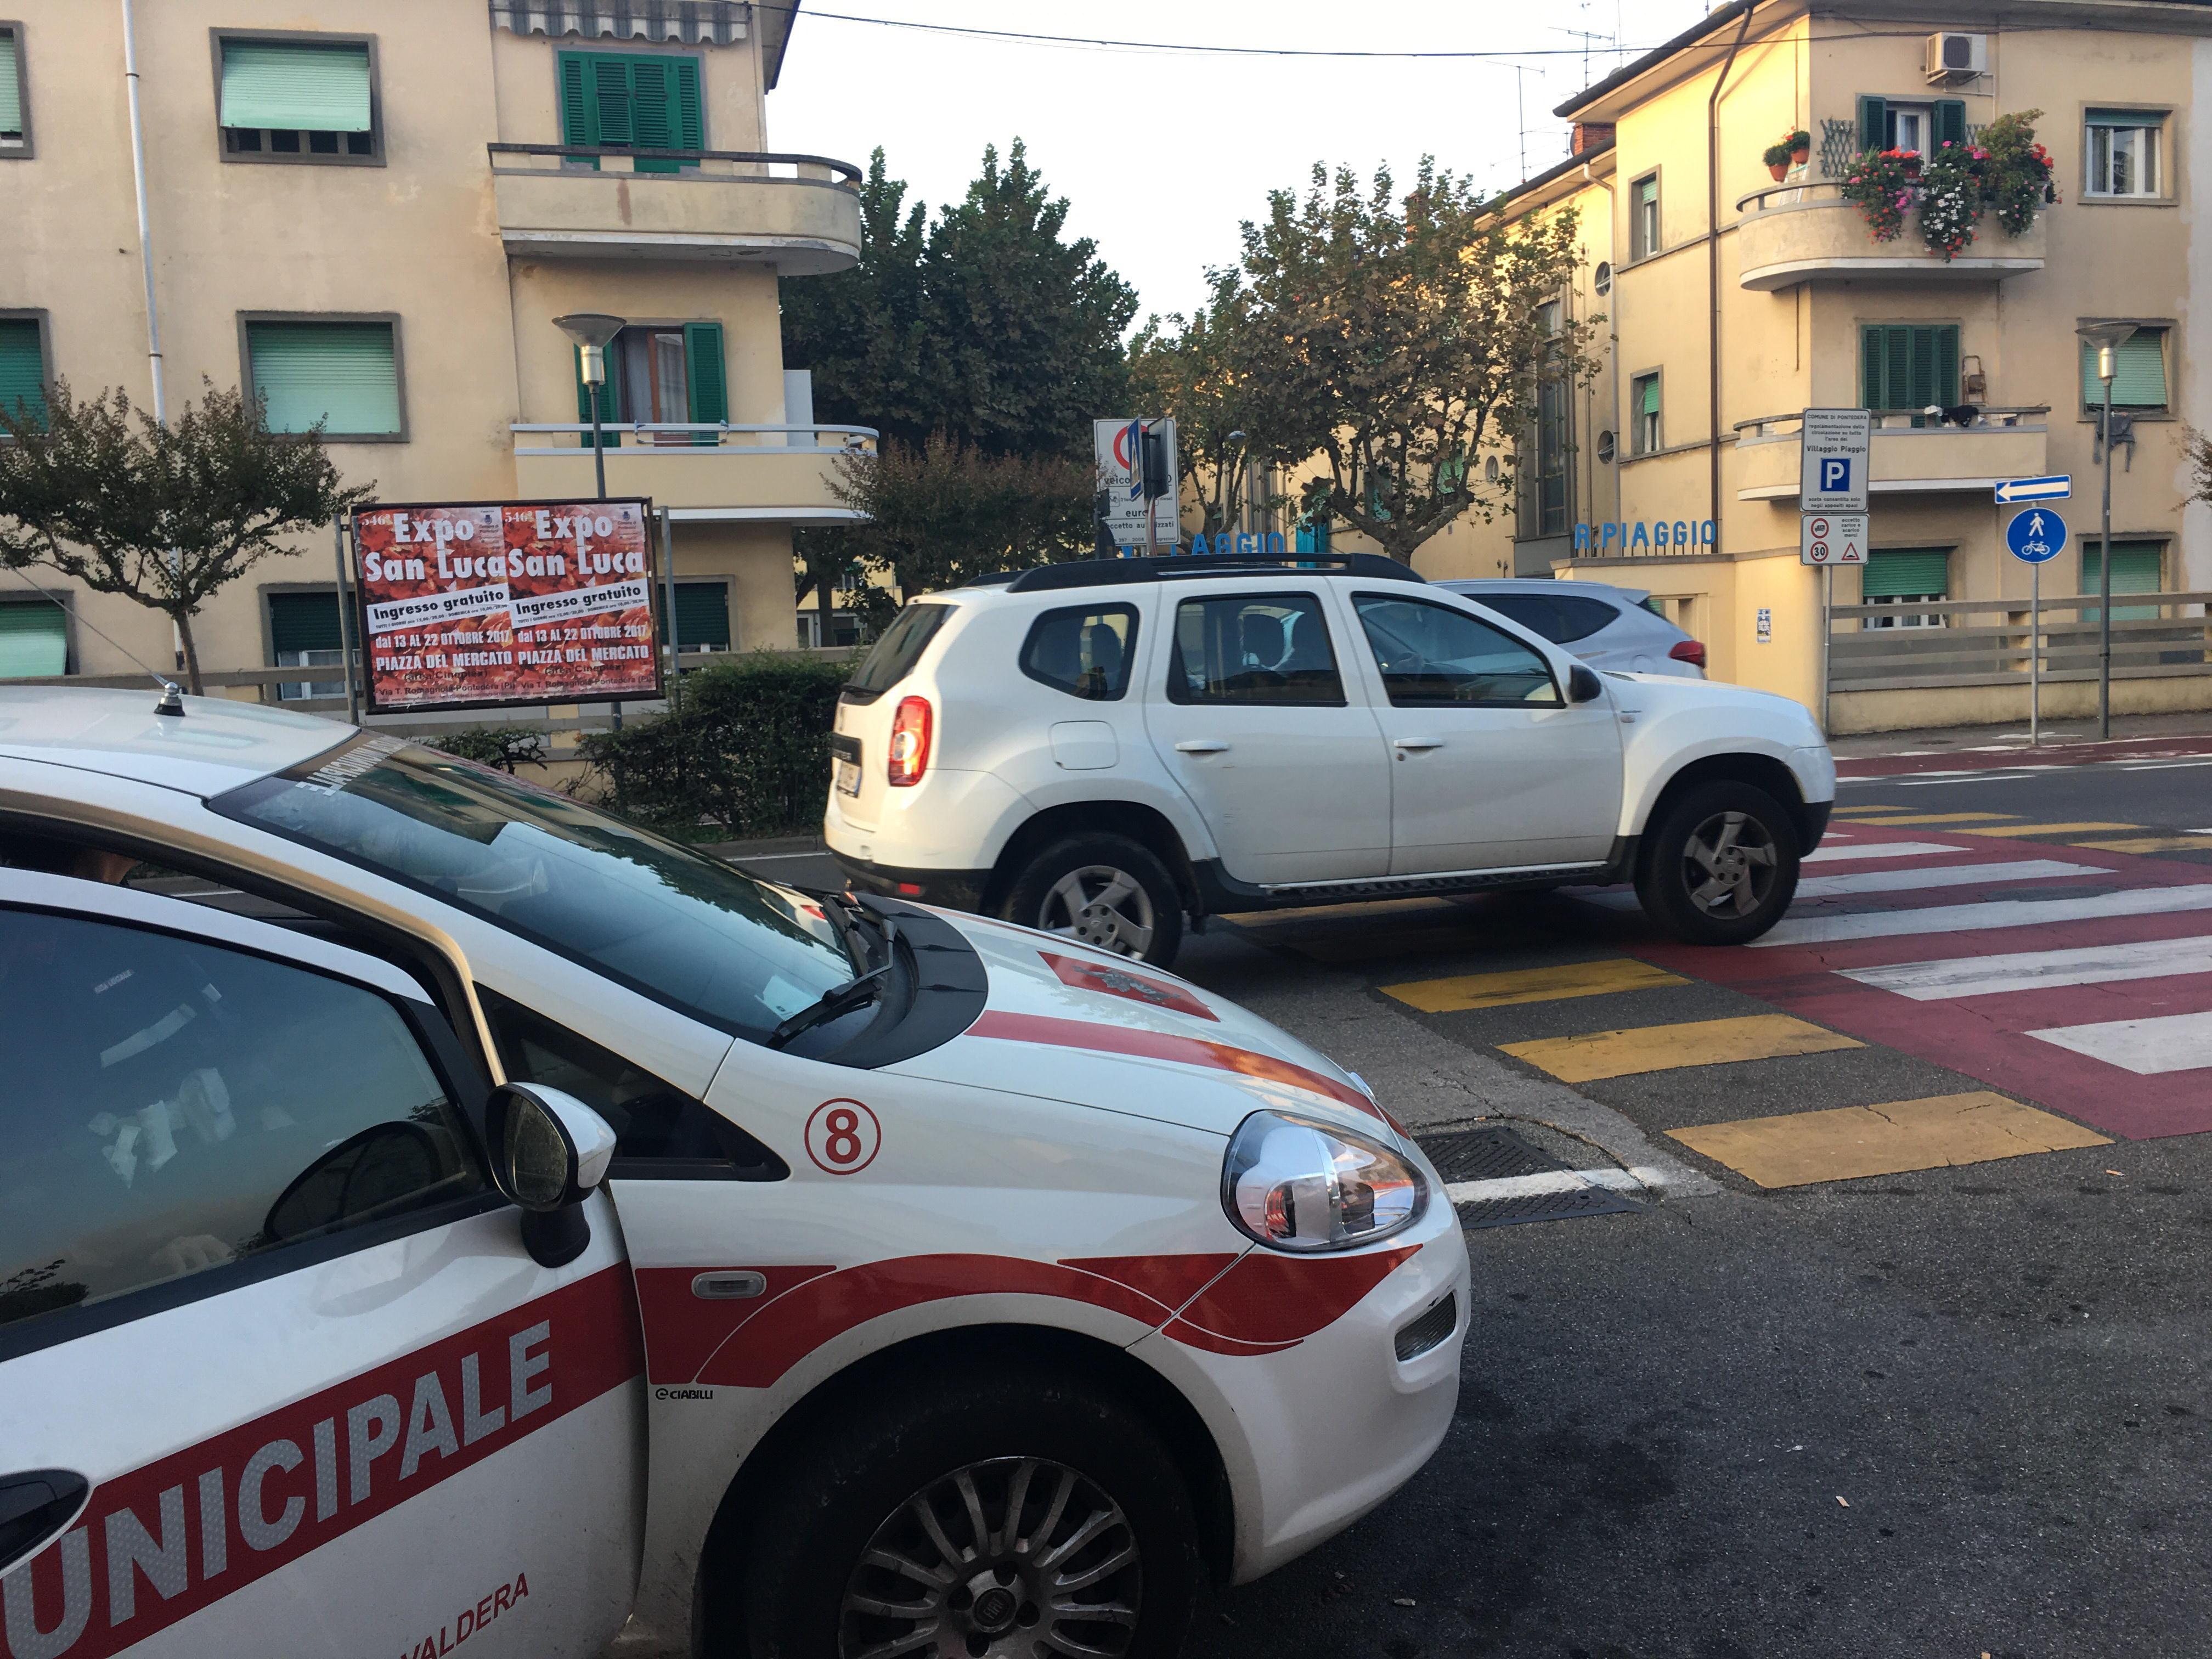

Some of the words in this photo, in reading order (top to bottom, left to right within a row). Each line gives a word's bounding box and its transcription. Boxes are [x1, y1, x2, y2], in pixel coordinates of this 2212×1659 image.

[1807, 445, 1838, 453] Villaggio
[1103, 476, 1130, 484] veico
[1826, 461, 1844, 488] P
[393, 513, 474, 549] Expo
[535, 510, 613, 546] Expo
[1814, 546, 1825, 556] 30
[365, 552, 425, 582] San
[437, 549, 506, 579] Luca
[508, 549, 566, 578] San
[577, 546, 644, 574] Luca
[374, 602, 438, 620] Ingresso
[443, 590, 504, 611] gratuito
[516, 597, 578, 615] Ingresso
[583, 586, 641, 606] gratuito
[376, 636, 391, 648] dal
[394, 635, 406, 647] 13
[410, 634, 421, 647] AL
[424, 633, 438, 646] 22
[441, 631, 484, 645] OTTOBRE
[487, 630, 510, 643] 2017
[518, 630, 533, 642] dal
[535, 630, 547, 642] 13
[550, 629, 562, 641] AL
[564, 628, 578, 641] 22
[580, 626, 622, 640] OTTOBRE
[624, 624, 646, 637] 2017
[376, 654, 422, 672] PIAZZA
[426, 653, 448, 669] DEL
[453, 651, 512, 668] MERCATO
[518, 649, 562, 665] PIAZZA
[566, 647, 588, 662] DEL
[591, 645, 649, 661] MERCATO
[379, 687, 393, 696] Via
[522, 681, 534, 689] Via
[826, 1109, 861, 1164] 8
